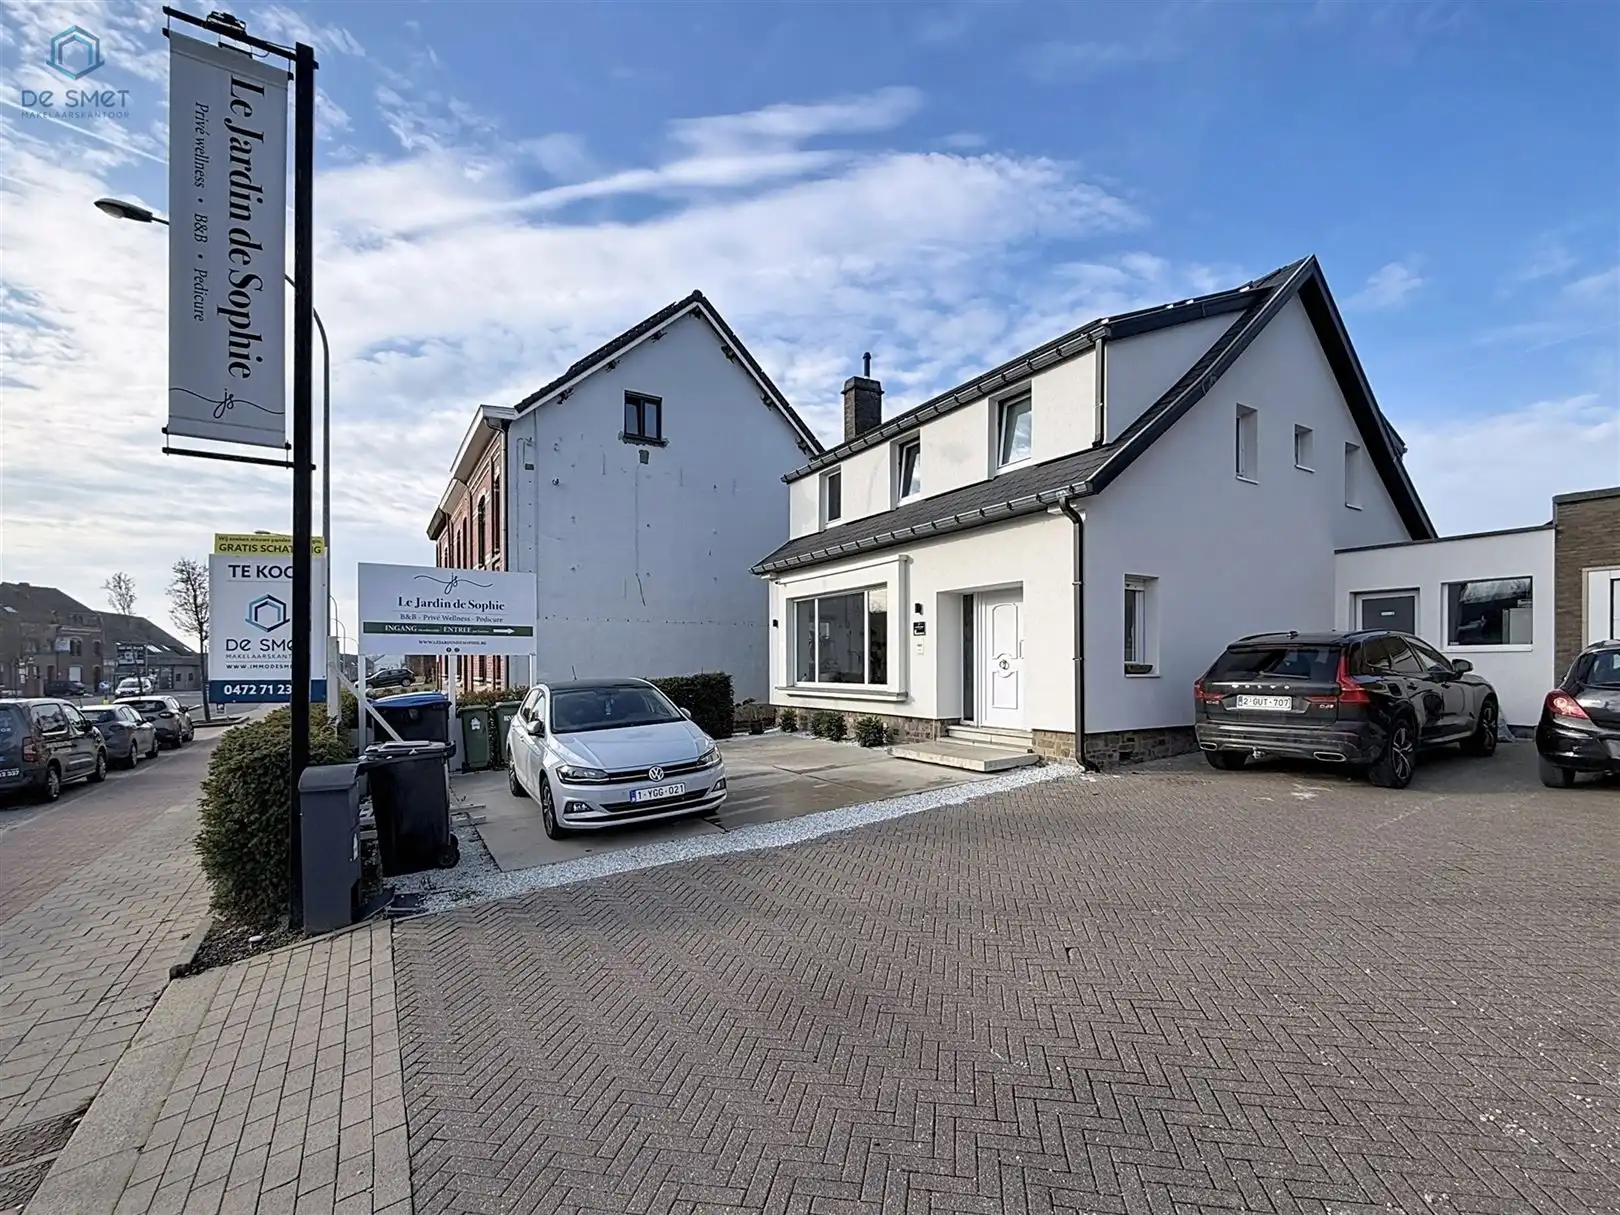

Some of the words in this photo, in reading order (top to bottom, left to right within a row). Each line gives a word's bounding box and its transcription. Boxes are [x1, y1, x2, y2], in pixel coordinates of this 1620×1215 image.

[229, 74, 265, 117] Le
[195, 102, 210, 136] Privé
[194, 138, 210, 188] wellness
[224, 117, 264, 221] Jardin
[194, 213, 208, 243] B&B
[228, 227, 264, 265] de
[194, 268, 208, 322] Pedicure
[217, 268, 264, 378] Sophie
[219, 543, 258, 553] GRATIS
[228, 564, 251, 578] TE
[398, 596, 413, 607] Le
[414, 597, 451, 608] Jardin
[453, 599, 466, 609] de
[468, 599, 505, 612] Sophie
[385, 624, 417, 632] INGANG
[224, 684, 257, 695] 0472
[259, 684, 274, 695] 71
[277, 684, 292, 695] 23
[638, 784, 684, 799] 1-YGG-021
